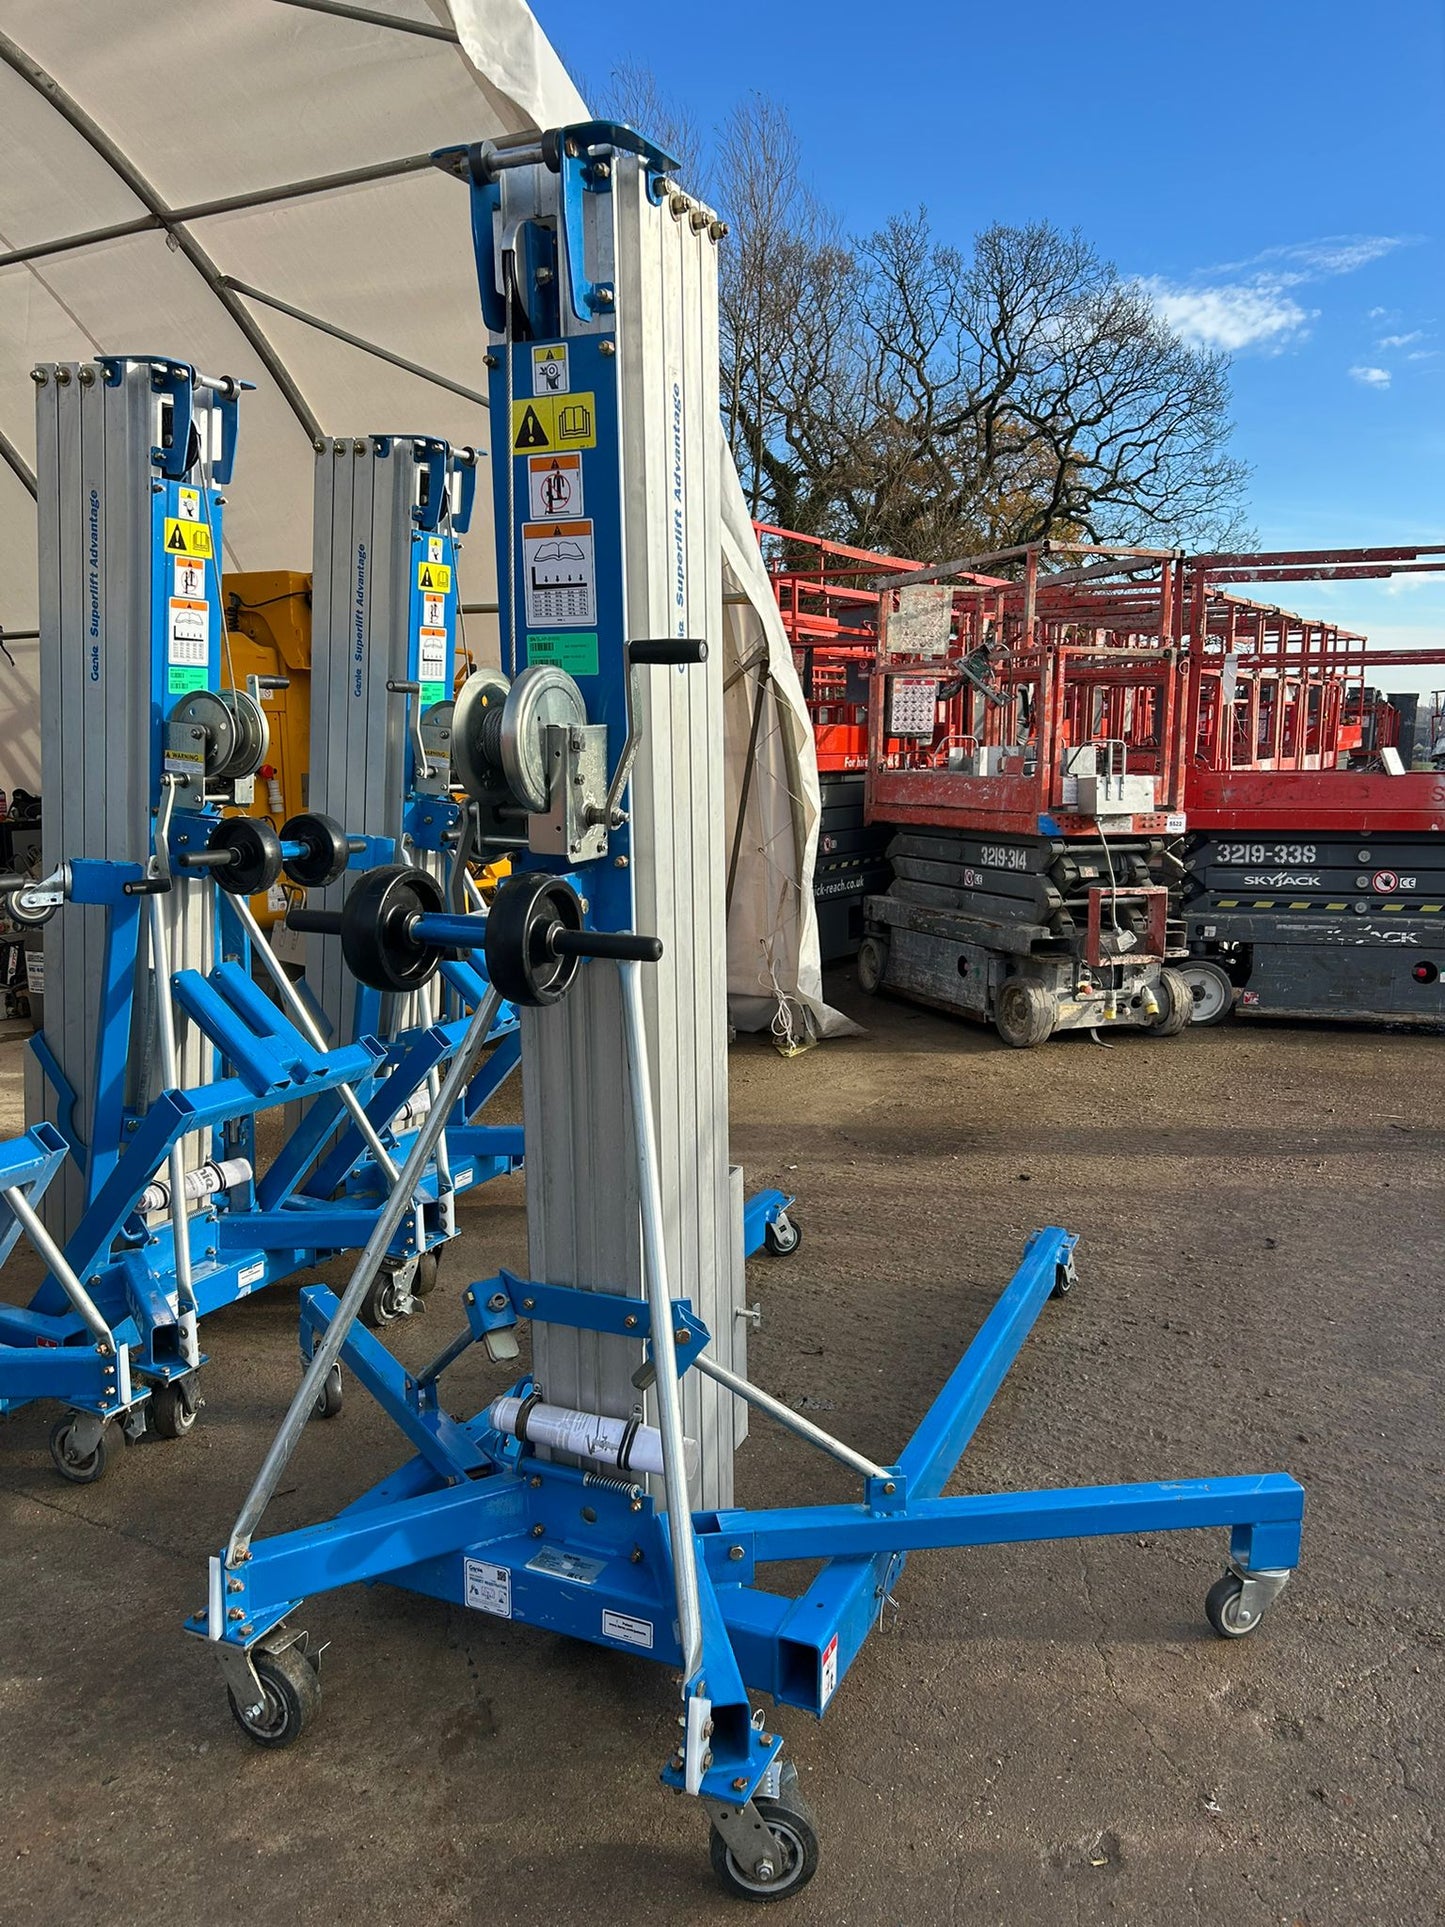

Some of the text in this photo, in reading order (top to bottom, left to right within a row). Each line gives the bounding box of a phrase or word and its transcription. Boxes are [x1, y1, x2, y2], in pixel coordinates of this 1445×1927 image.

[673, 383, 685, 674] Gie Superlift Advantage
[89, 489, 100, 682] Genie Superlift Advantage
[354, 543, 366, 698] Genie Superlift Advantage
[171, 752, 199, 761] WARNING
[1216, 844, 1317, 864] 3219-338
[1243, 872, 1321, 888] SKYJACK
